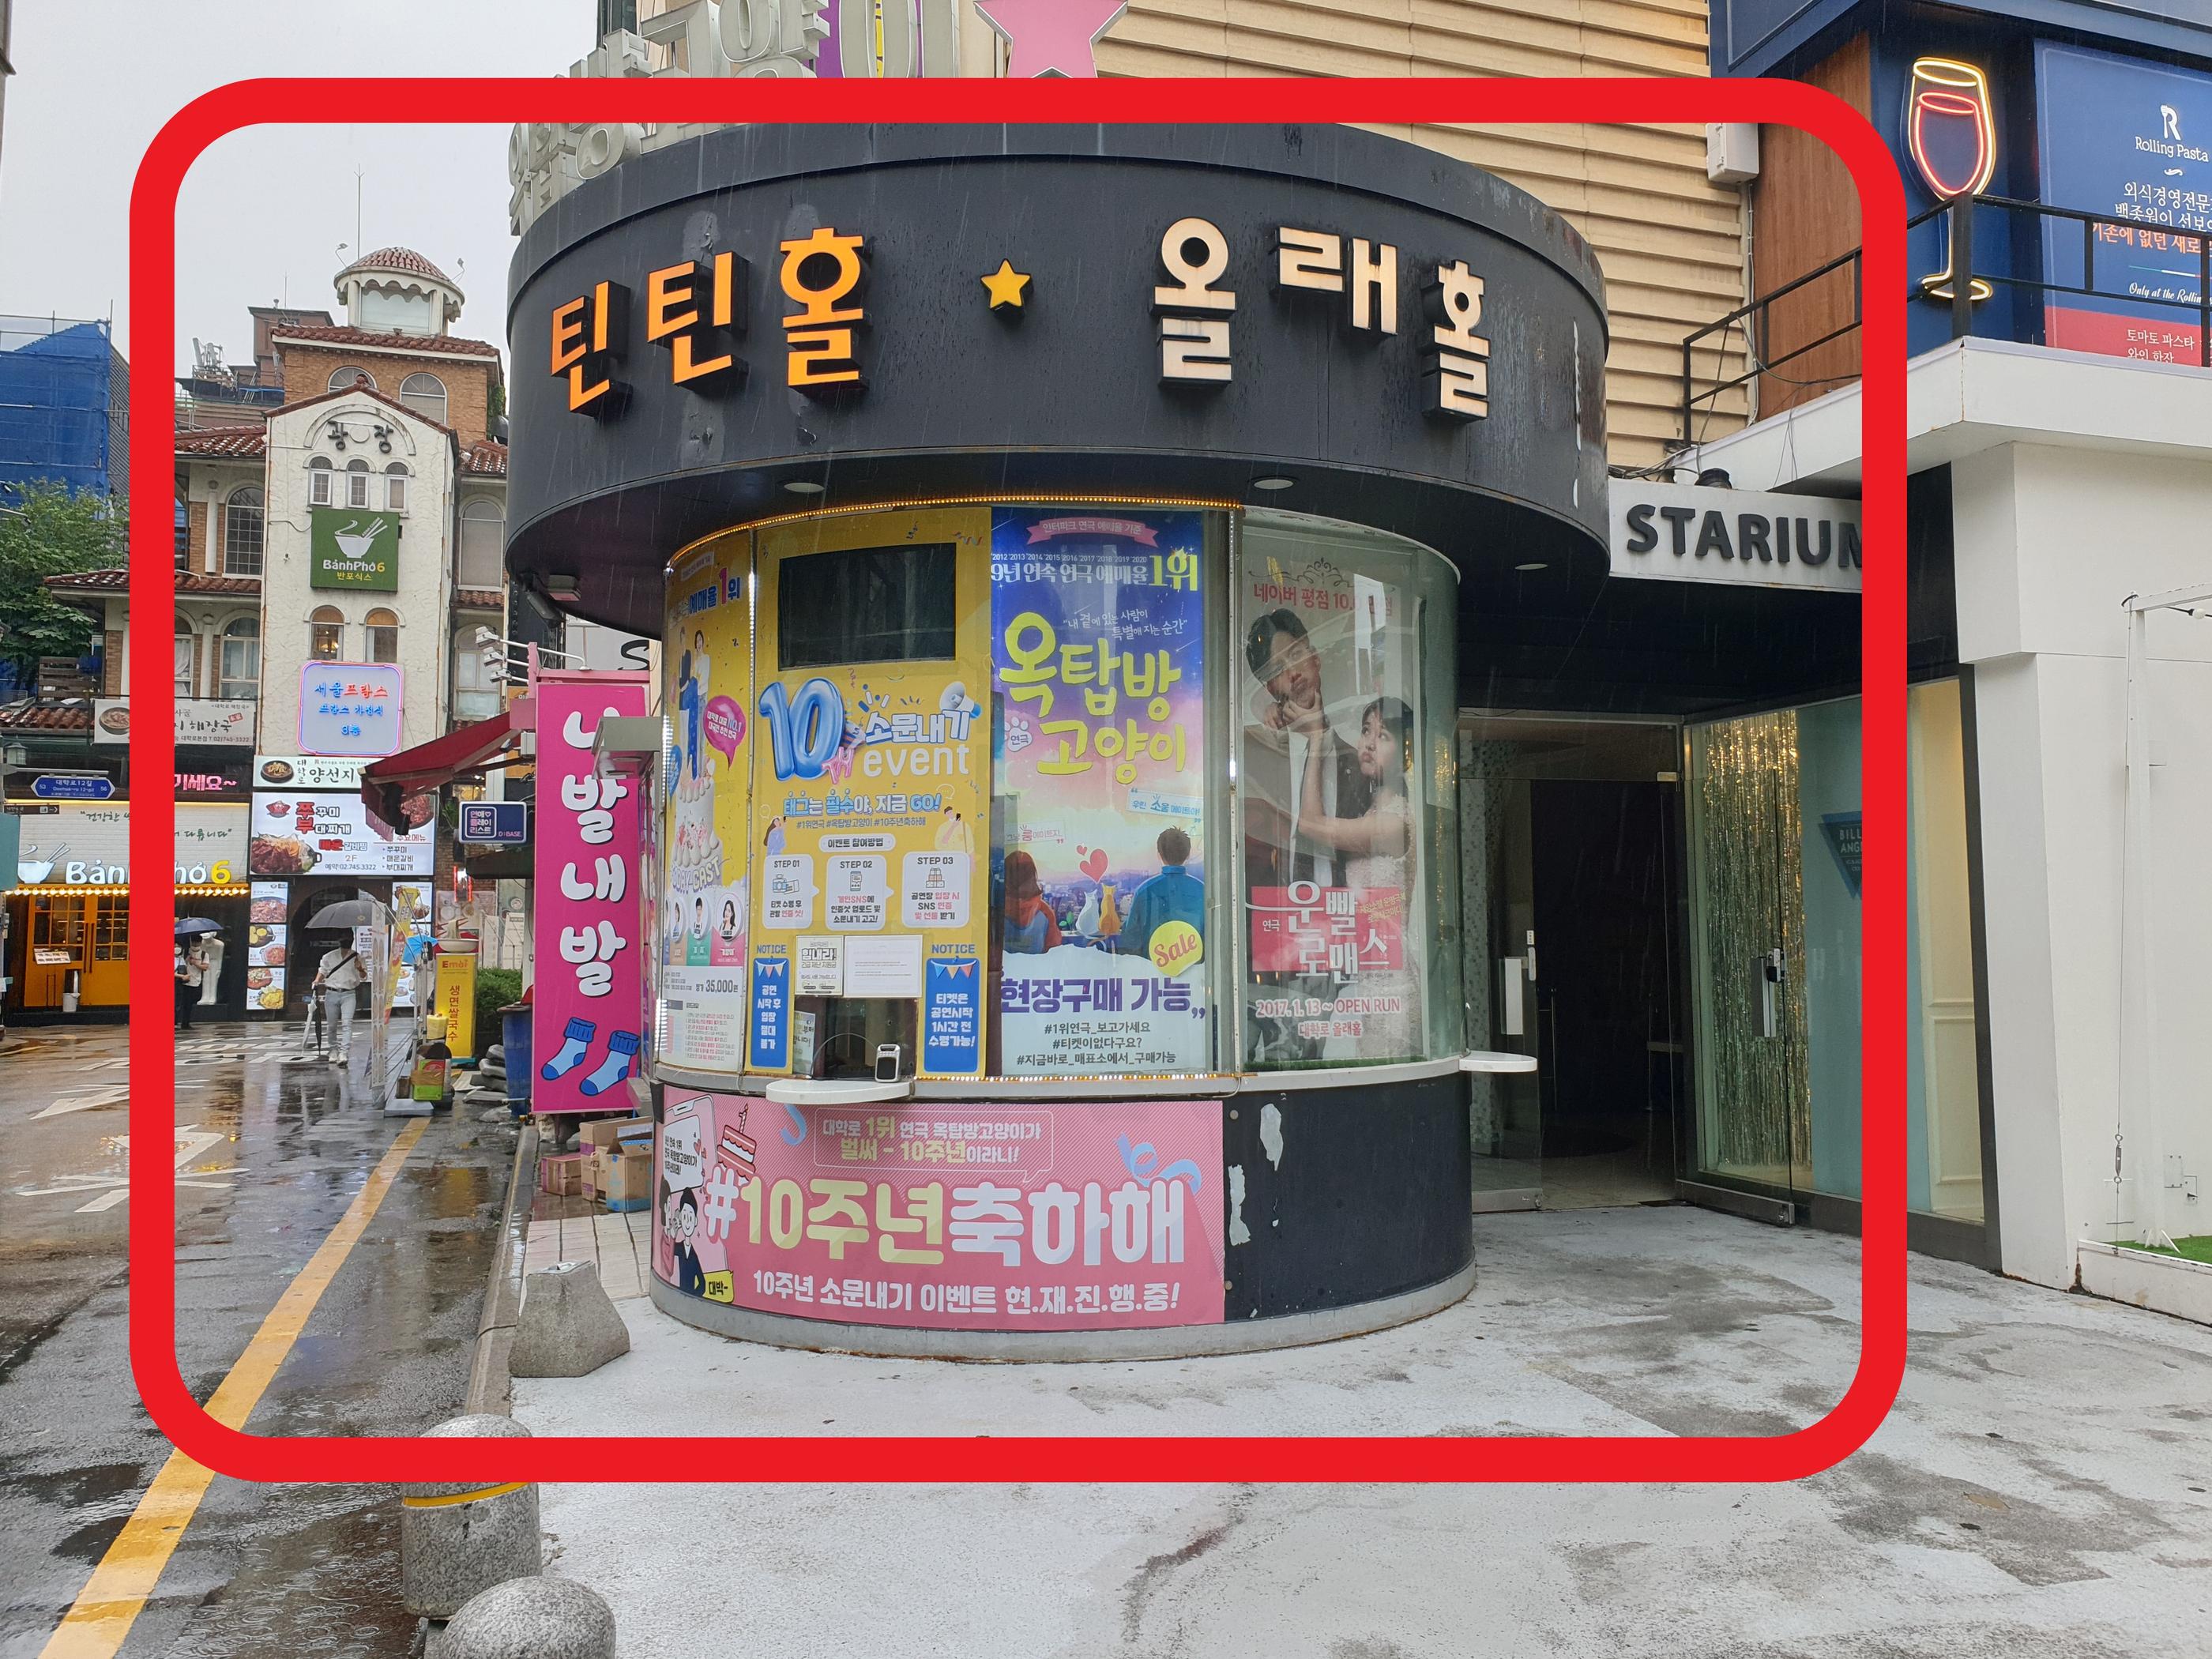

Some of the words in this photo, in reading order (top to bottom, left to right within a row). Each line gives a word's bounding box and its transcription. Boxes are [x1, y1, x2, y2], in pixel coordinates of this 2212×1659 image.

[2135, 136, 2173, 158] Rolling
[2176, 144, 2209, 163] Pasta
[2124, 182, 2212, 213] 외식경영전문
[2129, 282, 2149, 299] Only
[2163, 288, 2175, 299] the
[2177, 288, 2212, 304] Rollin
[551, 227, 864, 412] 틴틴홀
[1154, 216, 1491, 419] 올래홀
[2126, 329, 2160, 345] 토마토
[2162, 333, 2195, 350] 파스타
[337, 571, 373, 582] 반포식스
[991, 563, 1021, 583] 9년
[1023, 563, 1058, 583] 연속
[1059, 563, 1093, 584] 연극
[1096, 565, 1149, 585] 예매율
[1149, 553, 1198, 592] 1위
[1254, 583, 1297, 606] 네이버
[1301, 586, 1330, 611] 평점
[1080, 613, 1101, 628] 곁에
[1102, 611, 1119, 626] 있는
[1120, 608, 1149, 622] 사람이
[999, 611, 1182, 722] 옥탑방
[318, 703, 350, 715] 프랑스
[865, 709, 970, 746] 소문내기
[1010, 733, 1030, 745] 연극
[1036, 718, 1186, 784] 고양이
[863, 744, 970, 777] event
[308, 767, 355, 784] 양선지
[783, 794, 823, 818] 태그는
[875, 794, 908, 814] 지금
[910, 792, 942, 813] GO!
[826, 819, 873, 829] #옥탑방고양이
[874, 817, 926, 827] #10주년축하해
[827, 838, 851, 848] 이벤트
[852, 837, 885, 848] 참여방법
[344, 854, 358, 863] 2F
[774, 860, 792, 868] STEP
[840, 860, 861, 869] STEP
[692, 856, 722, 893] CAST
[833, 915, 860, 924] 소문내기
[940, 912, 955, 920] 받기
[1262, 919, 1281, 932] 연극
[756, 944, 787, 954] NOTICE
[931, 943, 976, 954] NOTICE
[1153, 933, 1198, 969] Sale
[762, 984, 778, 996] 공연
[1001, 978, 1123, 1014] 현장구매
[757, 999, 772, 1010] 시작
[773, 998, 782, 1009] 후
[935, 993, 969, 1005] 티켓은
[1334, 999, 1371, 1014] OPEN
[1373, 998, 1401, 1013] RUN
[448, 984, 461, 1042] 생면쌀국수
[931, 1006, 974, 1019] 공연시작
[931, 1021, 959, 1033] 1시간
[961, 1021, 972, 1033] 전
[1044, 1021, 1151, 1035] #1위연극_보고가세요
[1298, 1021, 1330, 1037] 대학로
[1332, 1021, 1362, 1036] 올래홀
[928, 1035, 976, 1048] 수령가능!
[1051, 1036, 1143, 1050] #티켓이없다구요?
[1016, 1051, 1177, 1066] #지금바로_매표소에서_구매가능
[822, 1119, 860, 1138] 대학로
[865, 1115, 896, 1139] 1위
[899, 1121, 929, 1139] 연극
[933, 1121, 1042, 1140] 옥탑방고양이가
[840, 1138, 878, 1161] 벌써
[900, 1140, 1021, 1164] 10주년이라니!
[705, 1166, 1185, 1267] #10주년축하해
[753, 1270, 814, 1303] 10주년
[820, 1275, 912, 1311] 소문내기
[920, 1282, 997, 1314] 이벤트
[1005, 1281, 1180, 1315] 현.재.진.행.중!
